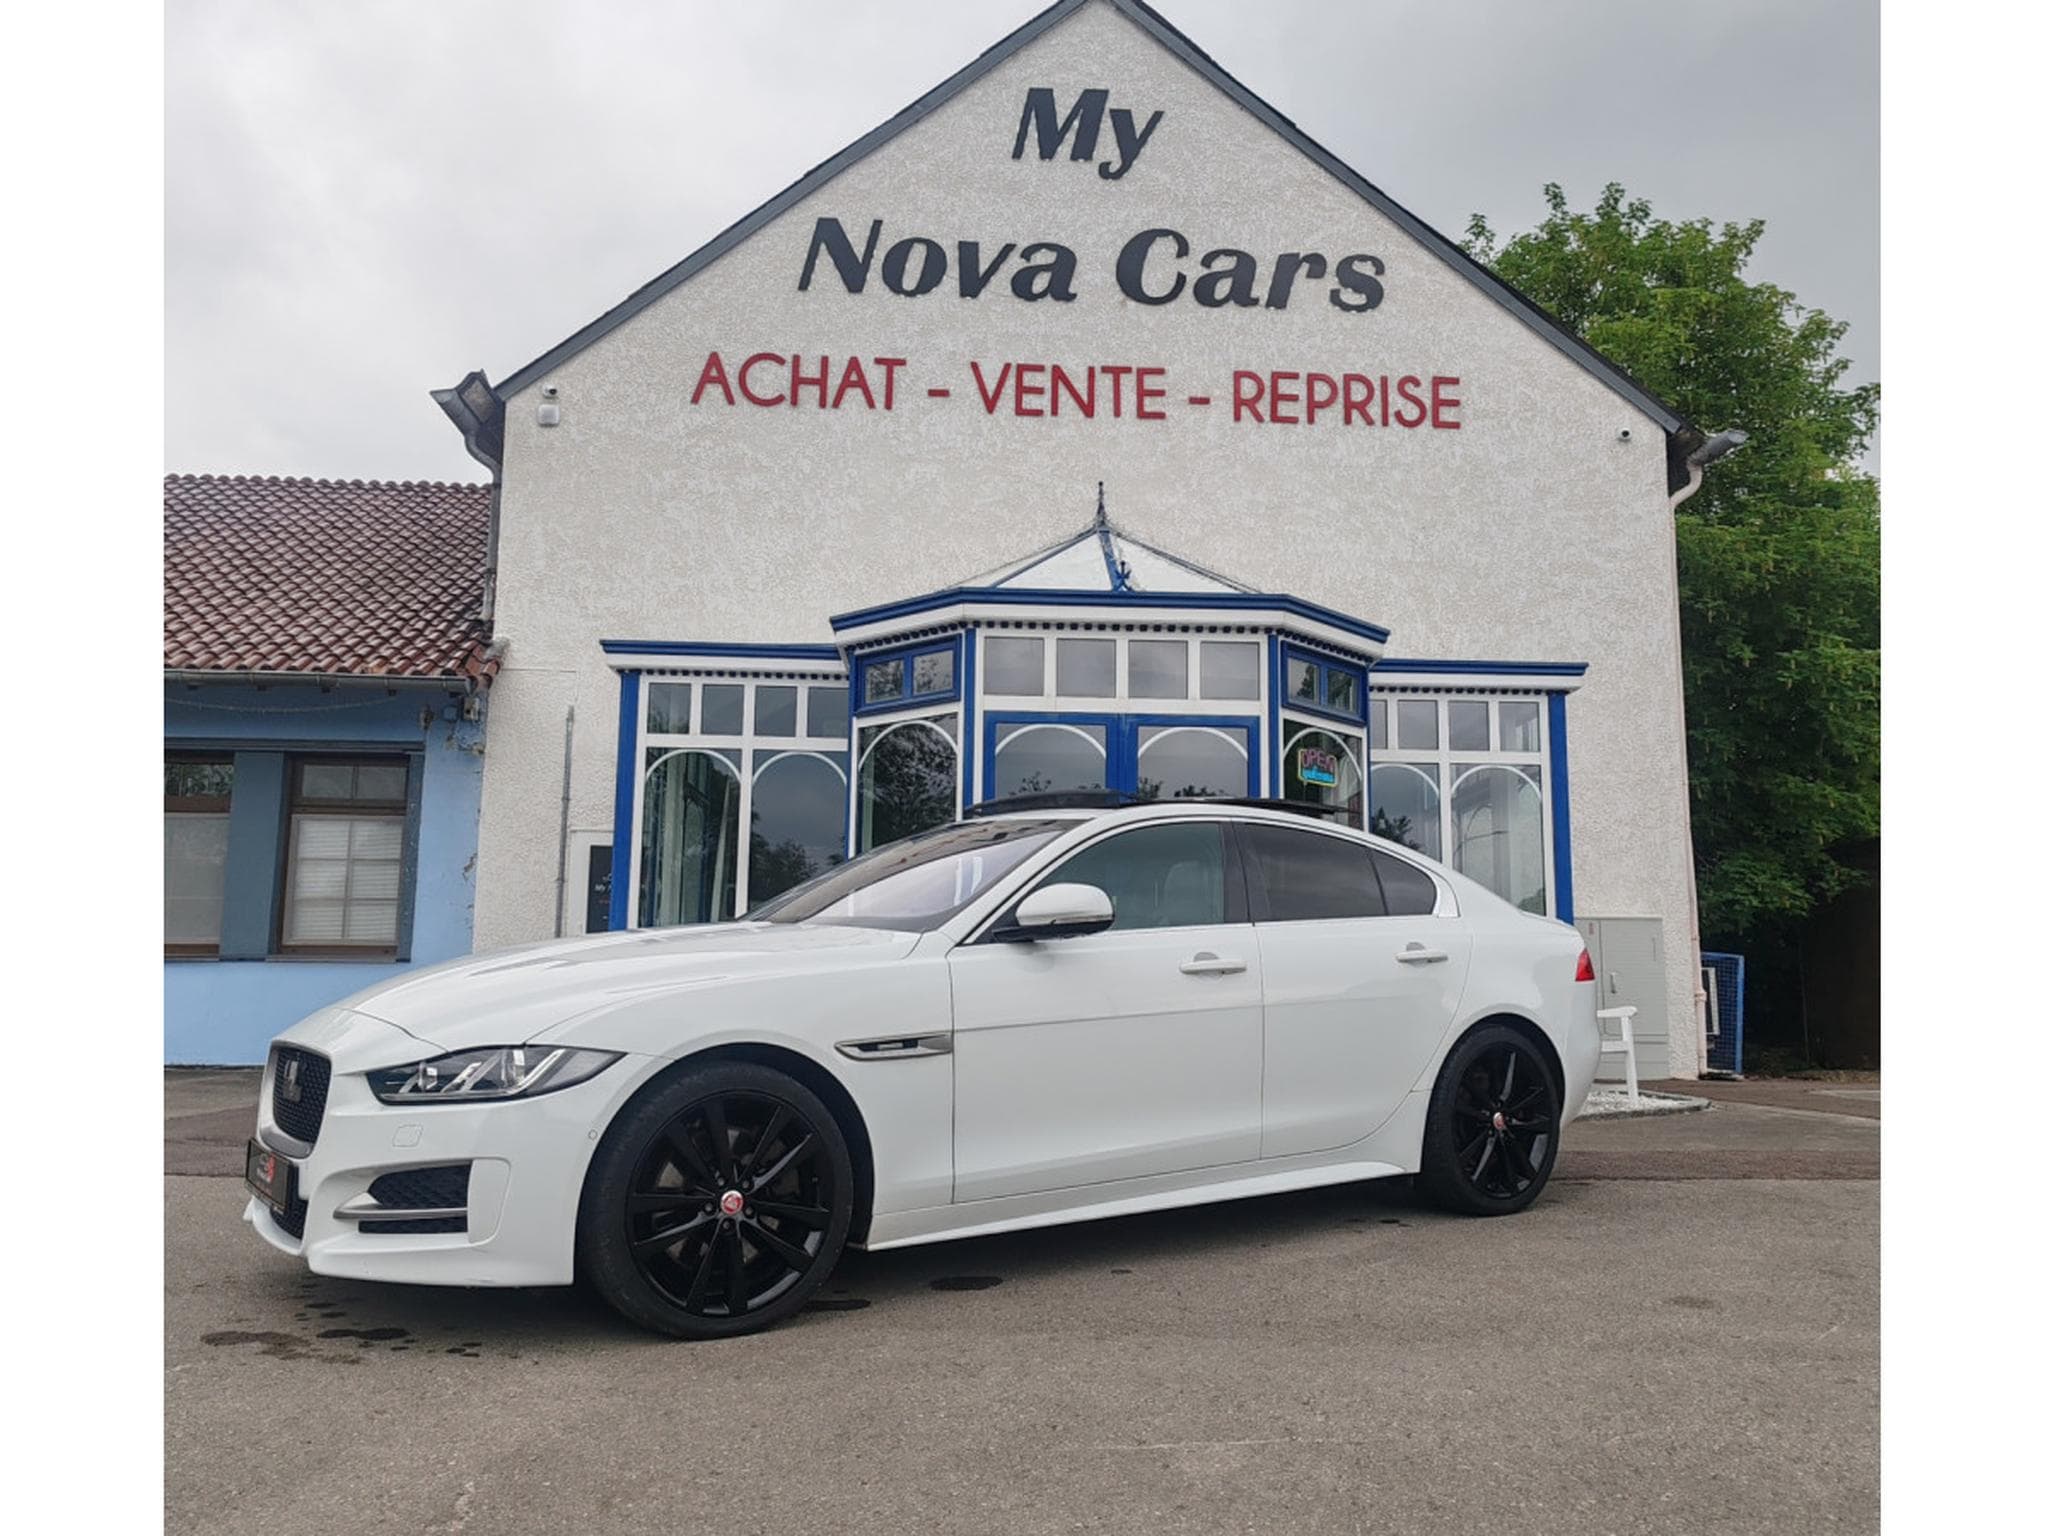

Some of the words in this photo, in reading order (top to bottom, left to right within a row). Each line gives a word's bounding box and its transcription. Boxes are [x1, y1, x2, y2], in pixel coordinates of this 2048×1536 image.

[1012, 87, 1165, 181] My
[798, 217, 1077, 303] Nova
[1115, 228, 1385, 313] Cars
[692, 352, 906, 409] ACHAT
[971, 362, 1166, 420] VENTE
[1234, 370, 1461, 430] REPRISE
[1302, 749, 1335, 772] OPEN
